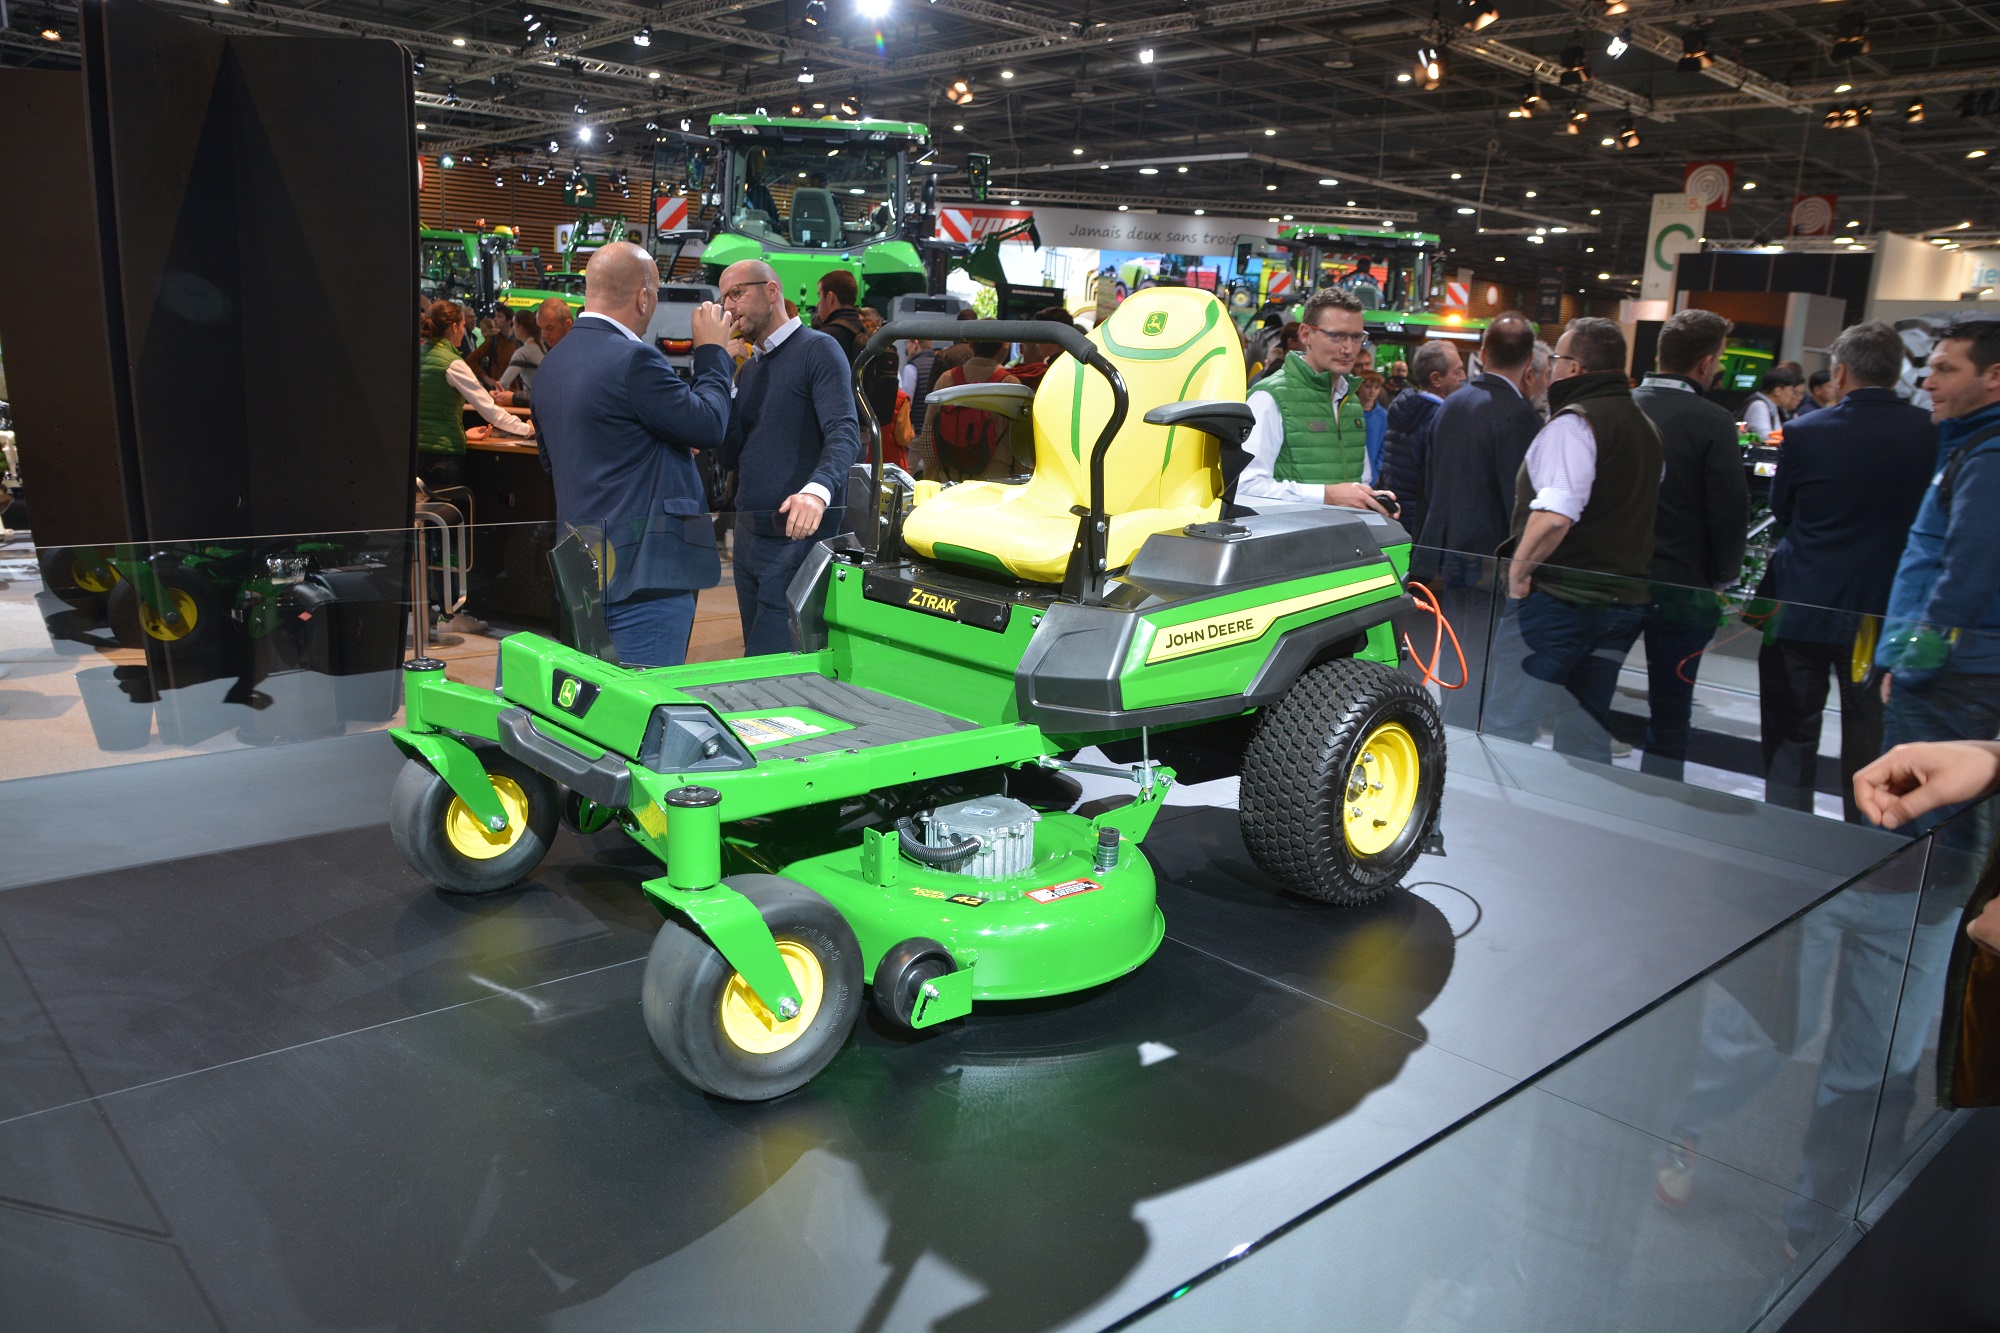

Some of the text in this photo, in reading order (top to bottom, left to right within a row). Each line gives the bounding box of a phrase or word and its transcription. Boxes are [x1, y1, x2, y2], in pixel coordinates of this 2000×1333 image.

[1069, 224, 1237, 246] Jamais deux sans trois
[908, 587, 958, 614] ZTRAK
[1165, 618, 1254, 649] JOHN DEERE
[1405, 701, 1438, 740] KENDA
[952, 896, 983, 906] 42
